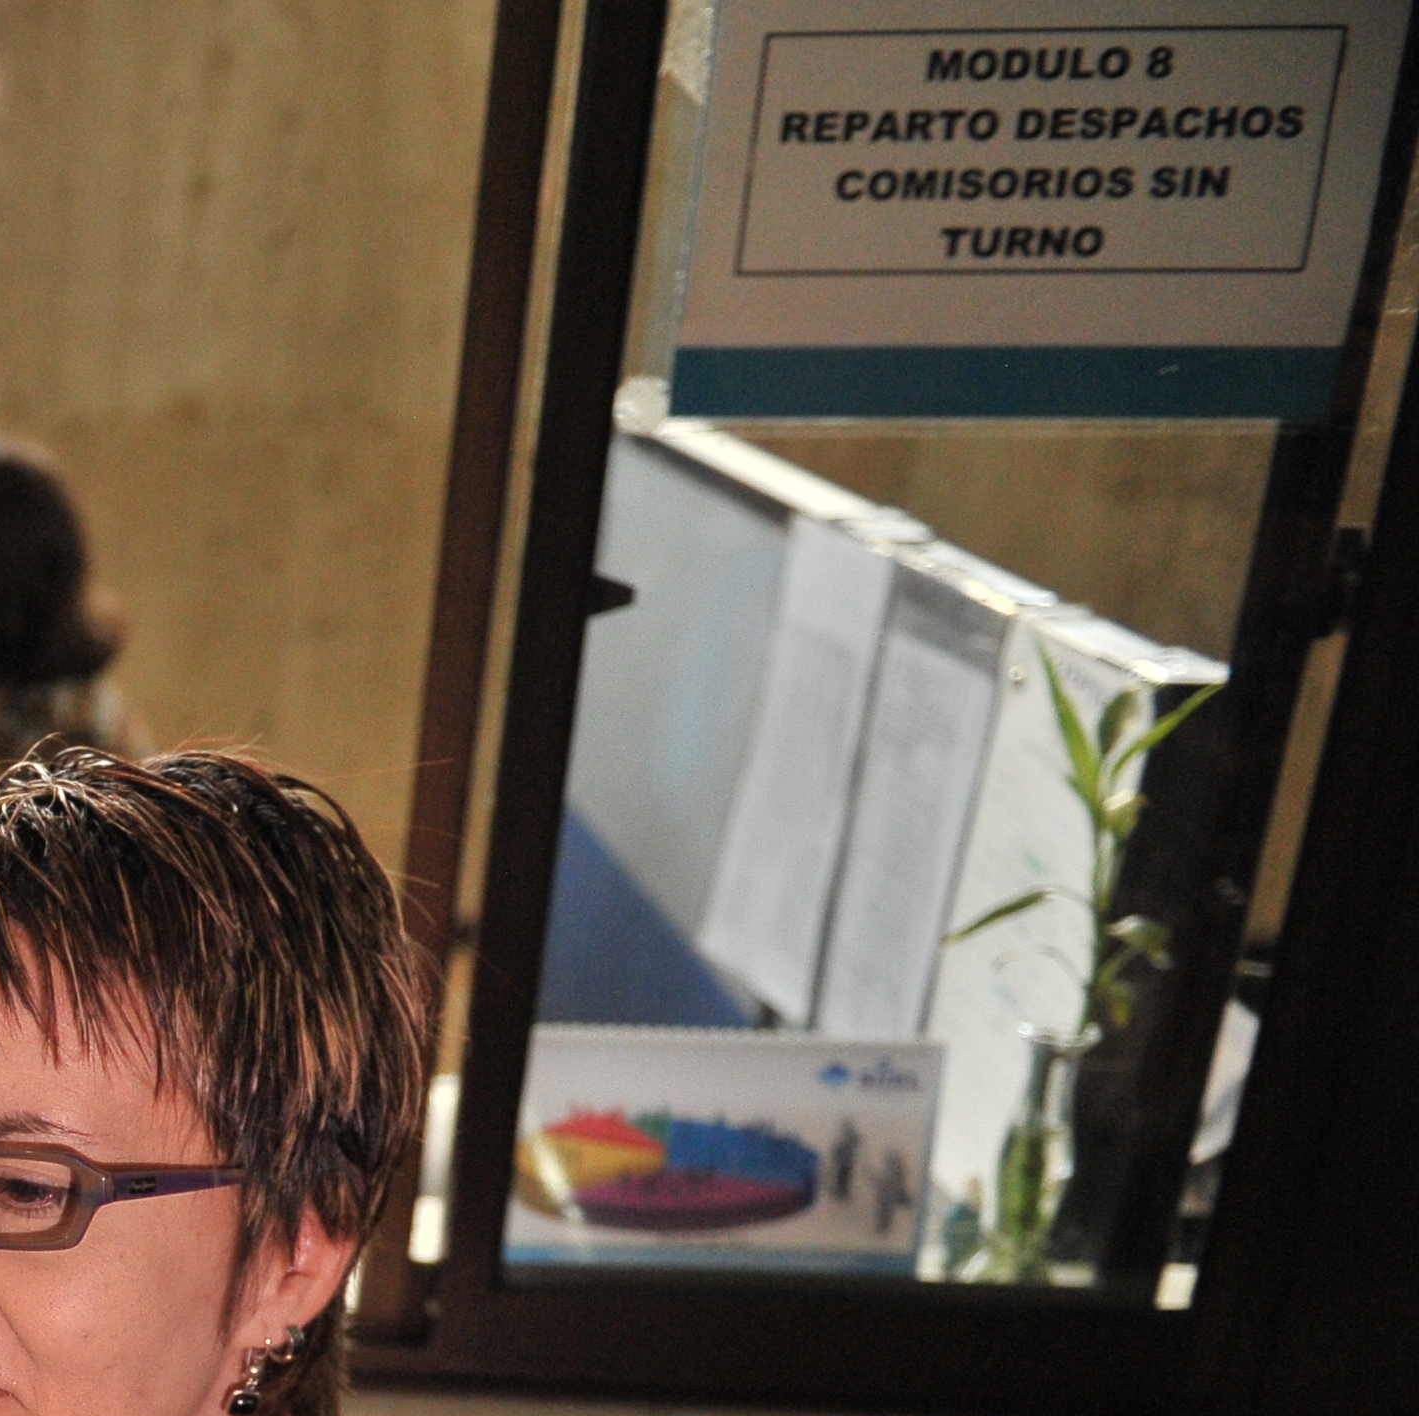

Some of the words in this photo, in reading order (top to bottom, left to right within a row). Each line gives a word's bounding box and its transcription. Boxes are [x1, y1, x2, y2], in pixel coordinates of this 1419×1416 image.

[925, 46, 1132, 82] MODULO
[1146, 45, 1174, 80] 8
[779, 108, 1000, 144] REPARTO
[1016, 105, 1305, 141] DESPACHOS
[834, 165, 1136, 202] COMISORIOS
[1149, 165, 1231, 199] SIN
[941, 225, 1105, 259] TURNO
